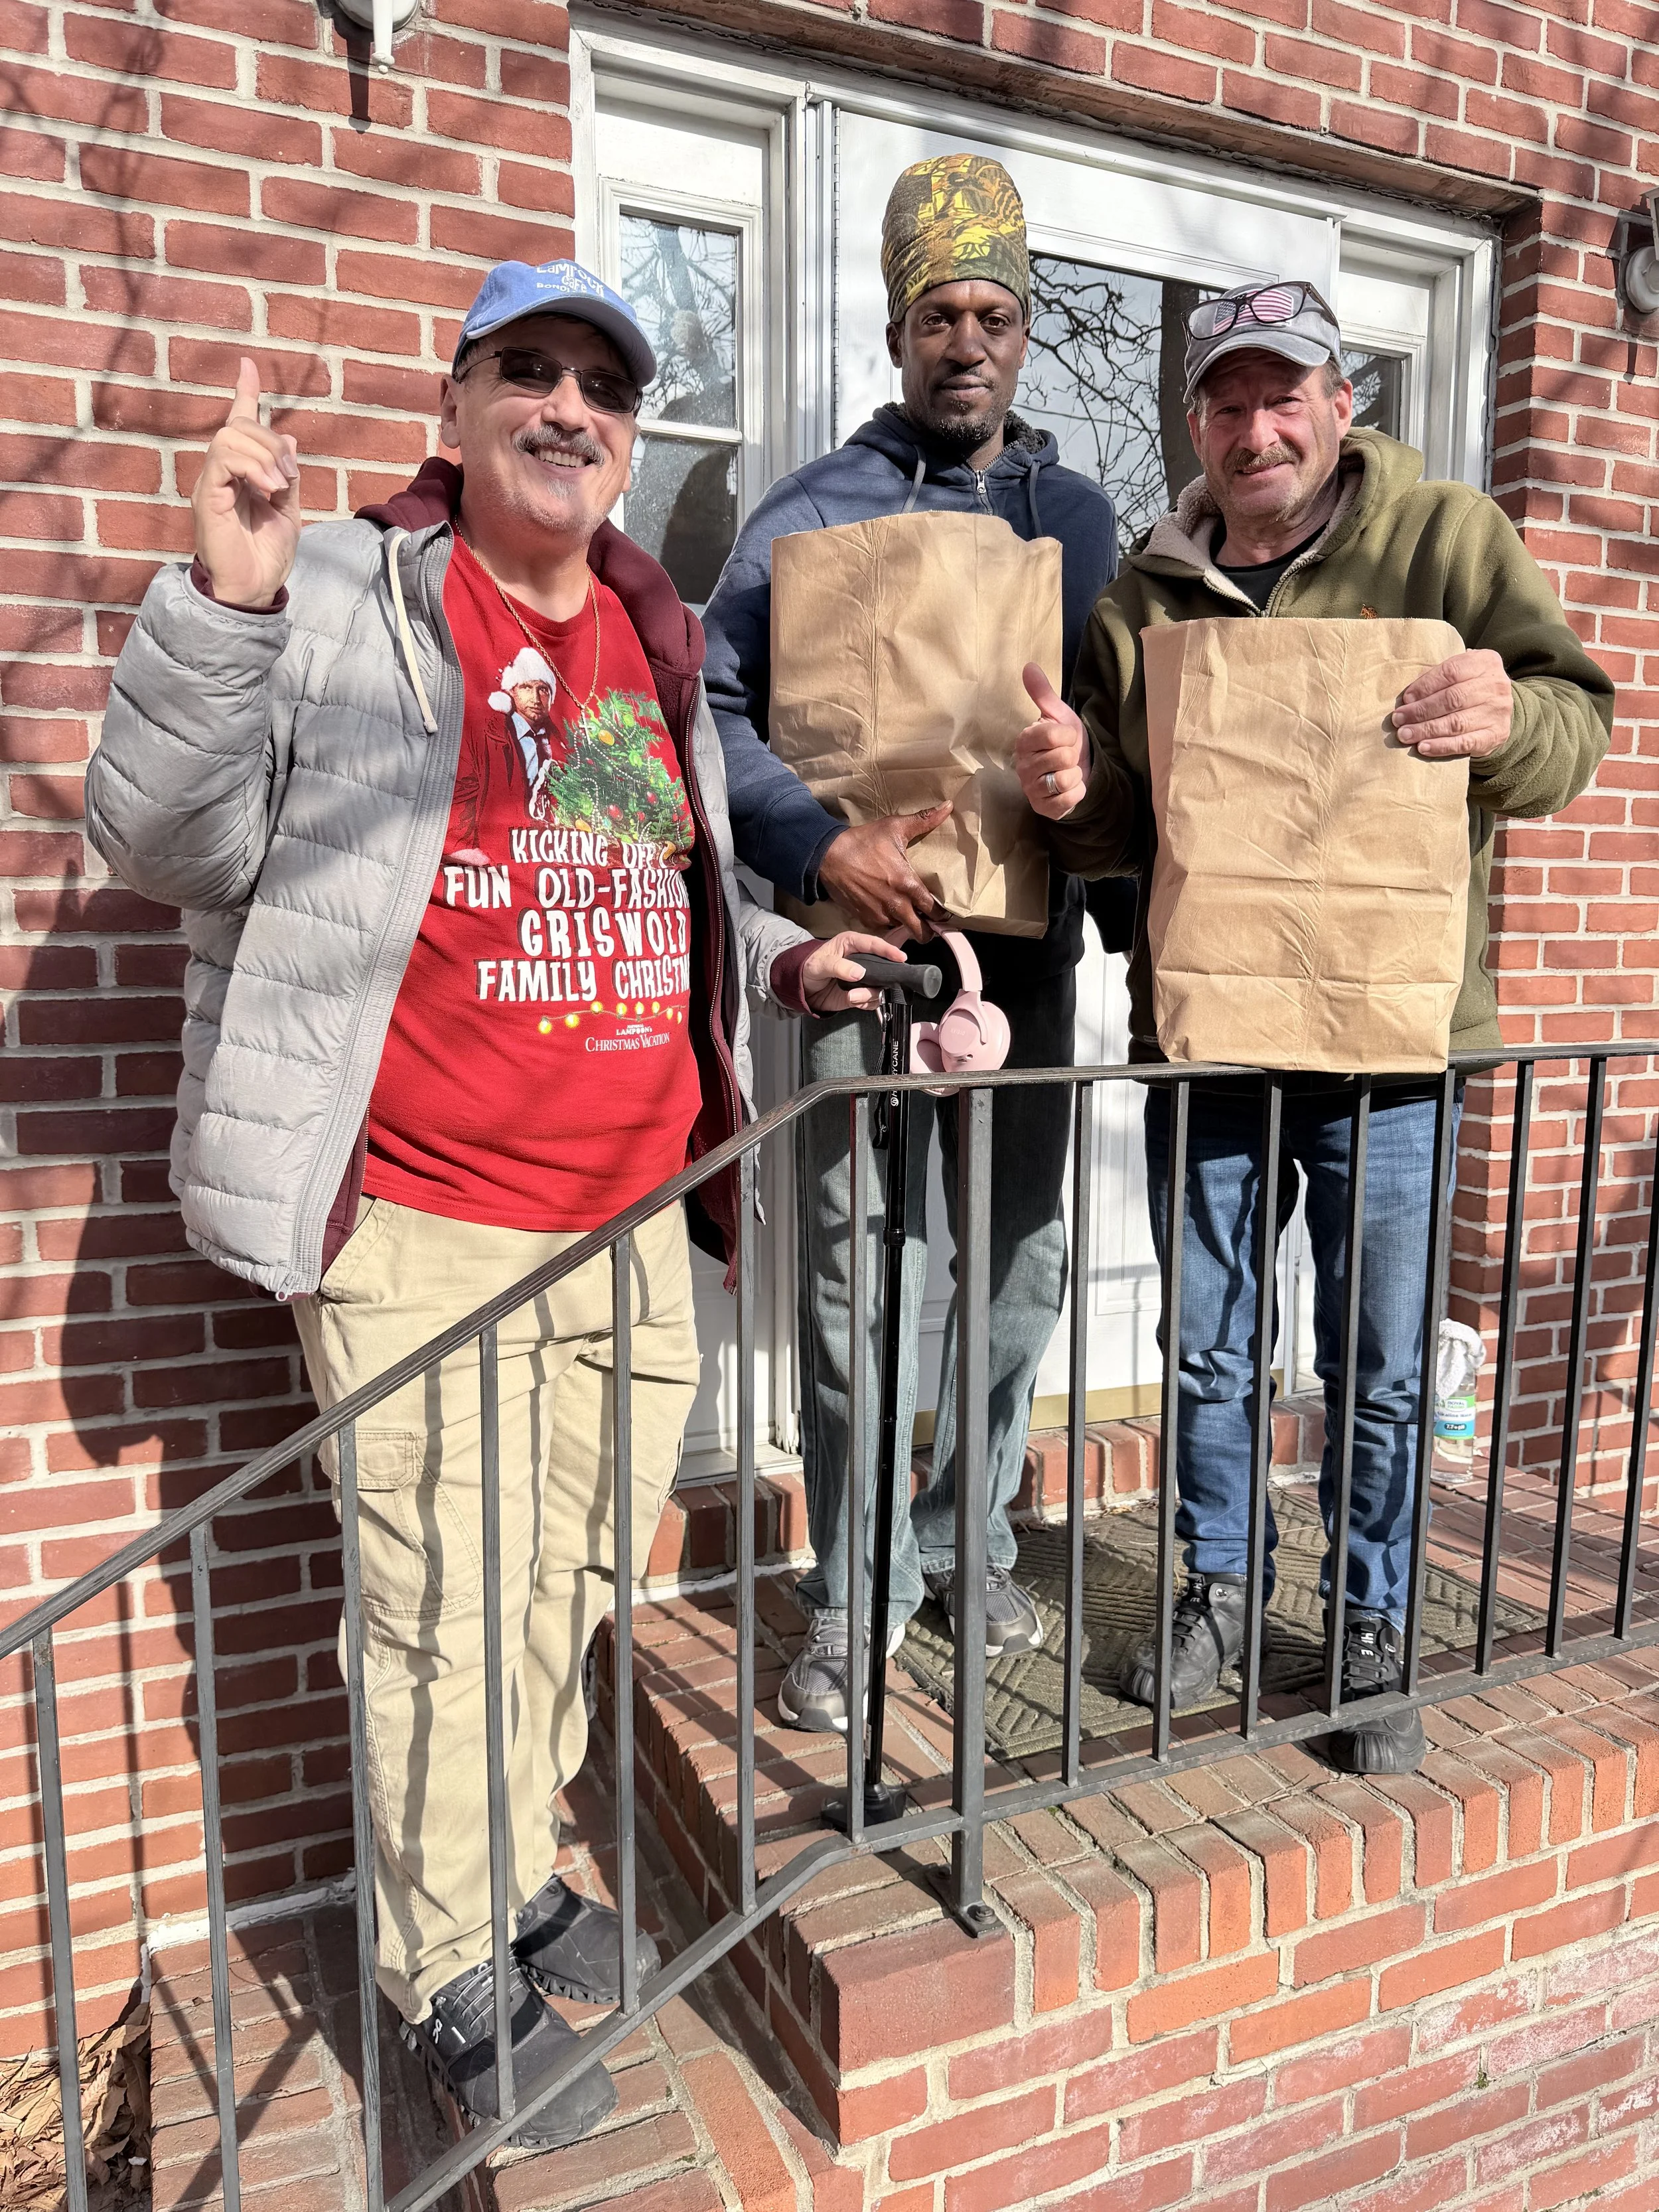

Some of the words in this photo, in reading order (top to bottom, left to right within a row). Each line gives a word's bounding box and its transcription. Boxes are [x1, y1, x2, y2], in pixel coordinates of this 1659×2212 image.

[536, 283, 570, 292] BONDI
[511, 830, 608, 866] KICKING
[443, 865, 512, 909] FUN
[521, 907, 686, 959] GRISWOLD
[477, 960, 597, 1002] FAMILY
[585, 1037, 640, 1052] CHRISTMAS
[640, 1032, 670, 1048] VACATION
